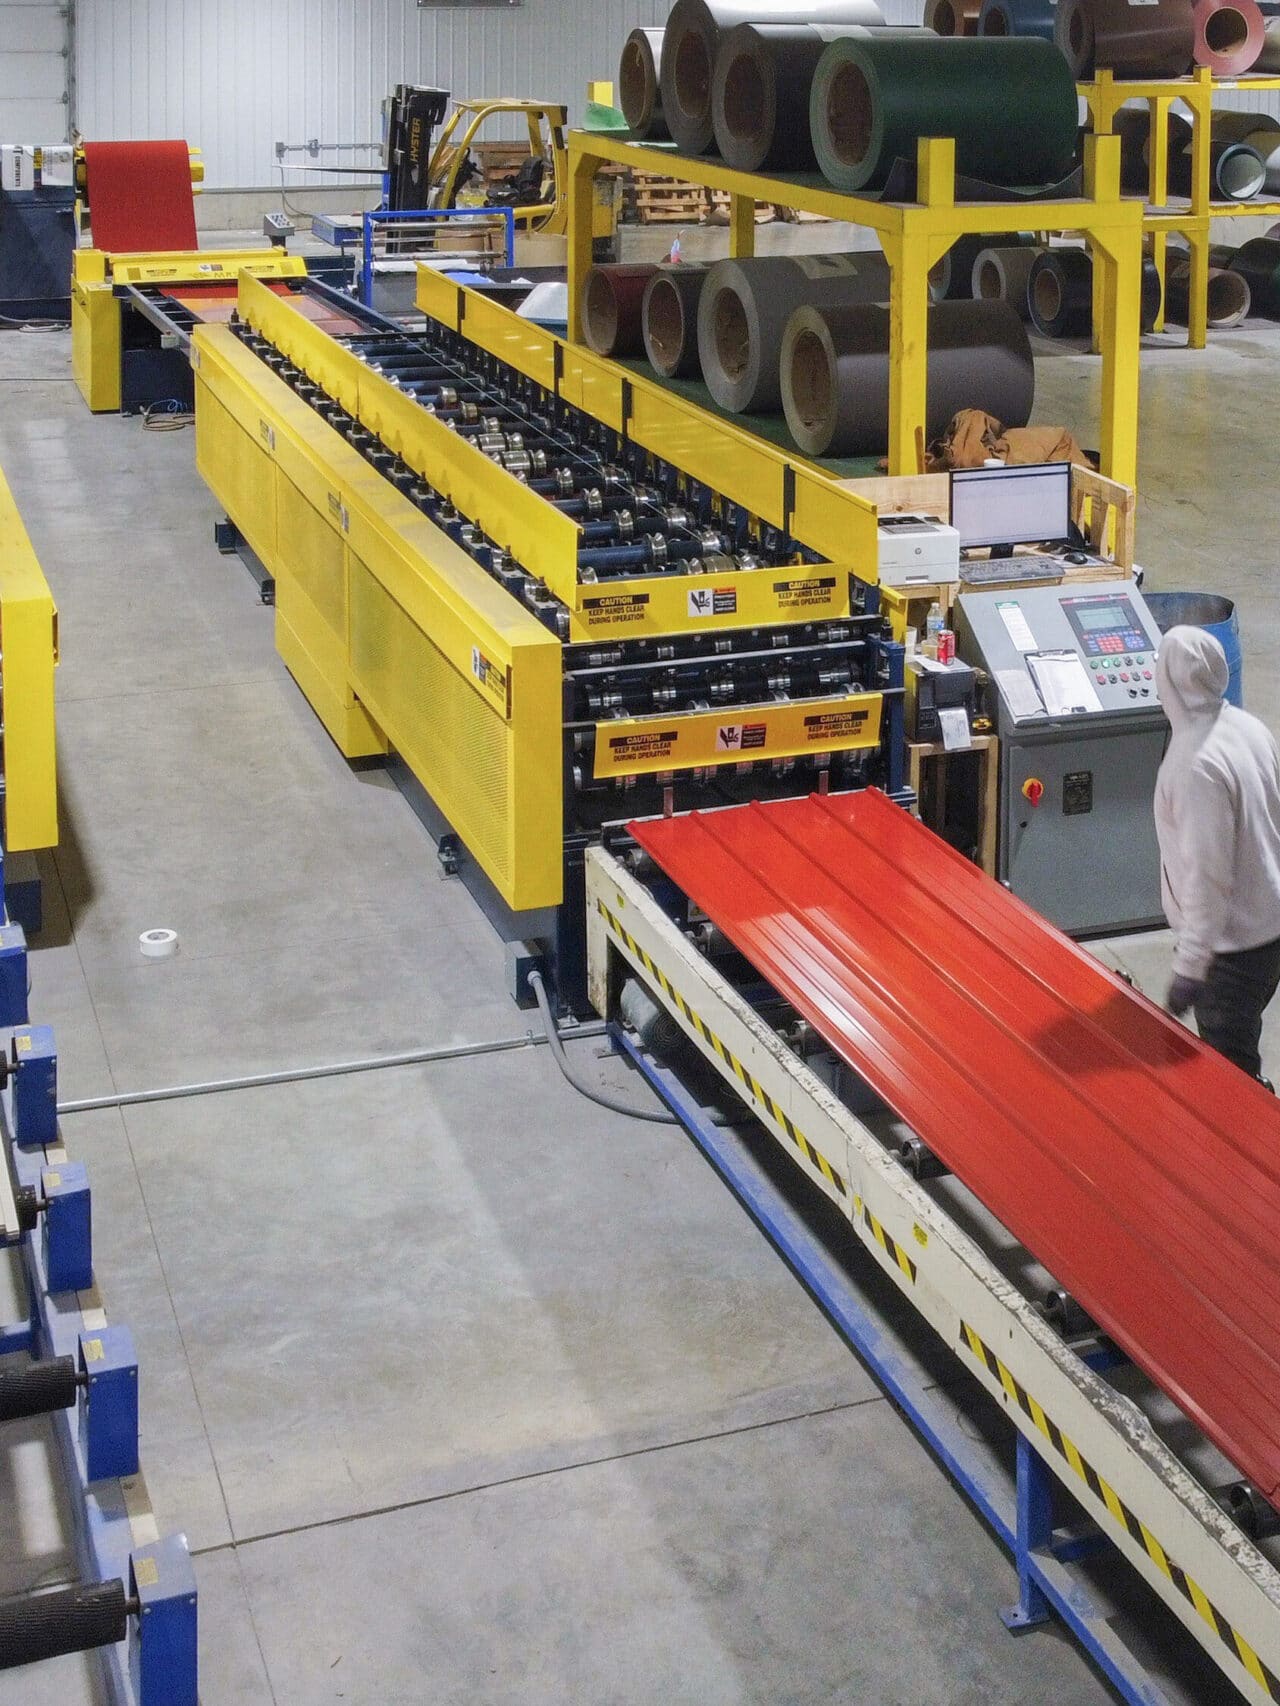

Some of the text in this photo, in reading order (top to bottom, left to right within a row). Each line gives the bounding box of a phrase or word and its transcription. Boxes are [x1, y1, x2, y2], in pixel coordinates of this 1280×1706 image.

[410, 117, 421, 162] HYSTER
[788, 580, 820, 590] CAUTION
[778, 588, 831, 599] KEEP HANDS CLEAR
[600, 596, 633, 606] CAUTION
[778, 596, 831, 608] DURING OPERATION
[588, 605, 645, 616] KEEP HANDS CLEAR
[588, 613, 645, 625] DURING OPERATION
[820, 713, 852, 723] CAUTION
[808, 721, 862, 732] KEEP HANDS CLEAR
[626, 734, 660, 745] CAUTION
[807, 728, 861, 740] DURING OPERATION
[614, 742, 671, 754] KEEP HANDS CLEAR
[613, 749, 671, 762] DURING OPERATION
